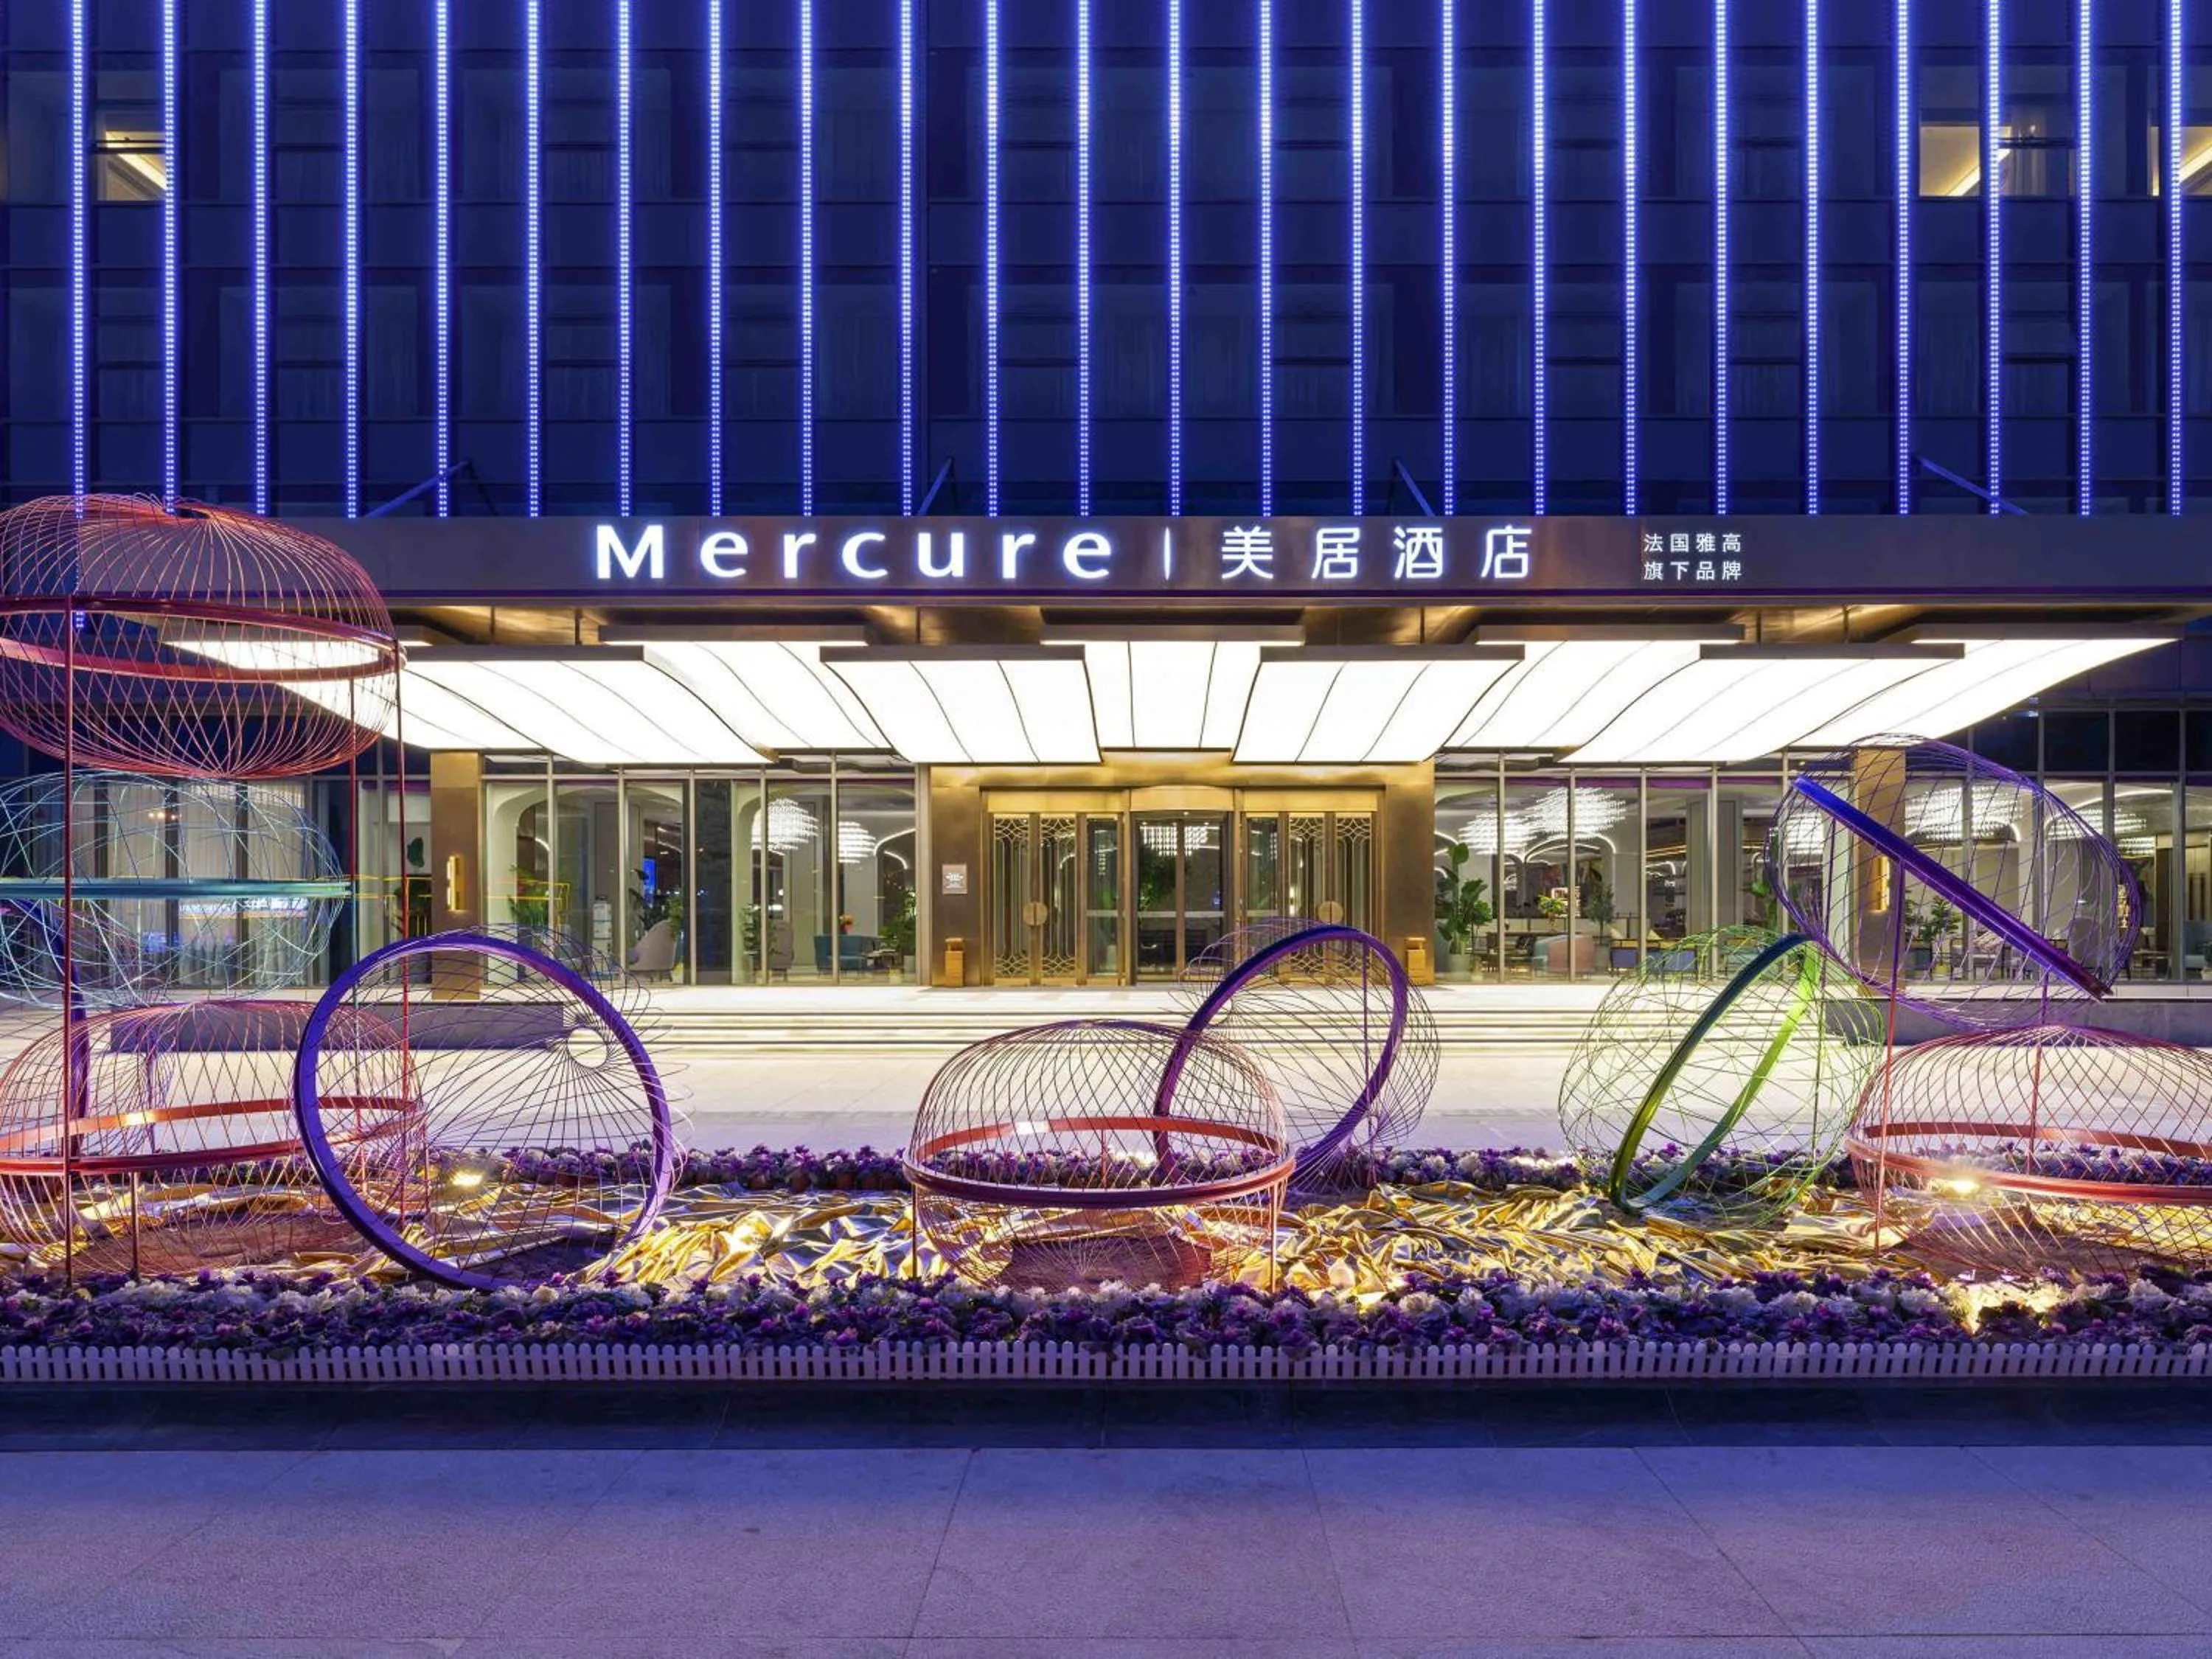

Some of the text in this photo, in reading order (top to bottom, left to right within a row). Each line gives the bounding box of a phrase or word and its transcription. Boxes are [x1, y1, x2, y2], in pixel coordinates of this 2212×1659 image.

[596, 524, 1113, 579] Mercure
[1221, 525, 1533, 580] 美居酒店
[1644, 532, 1742, 552] 法国雅高
[1644, 560, 1742, 580] 旗下品牌
